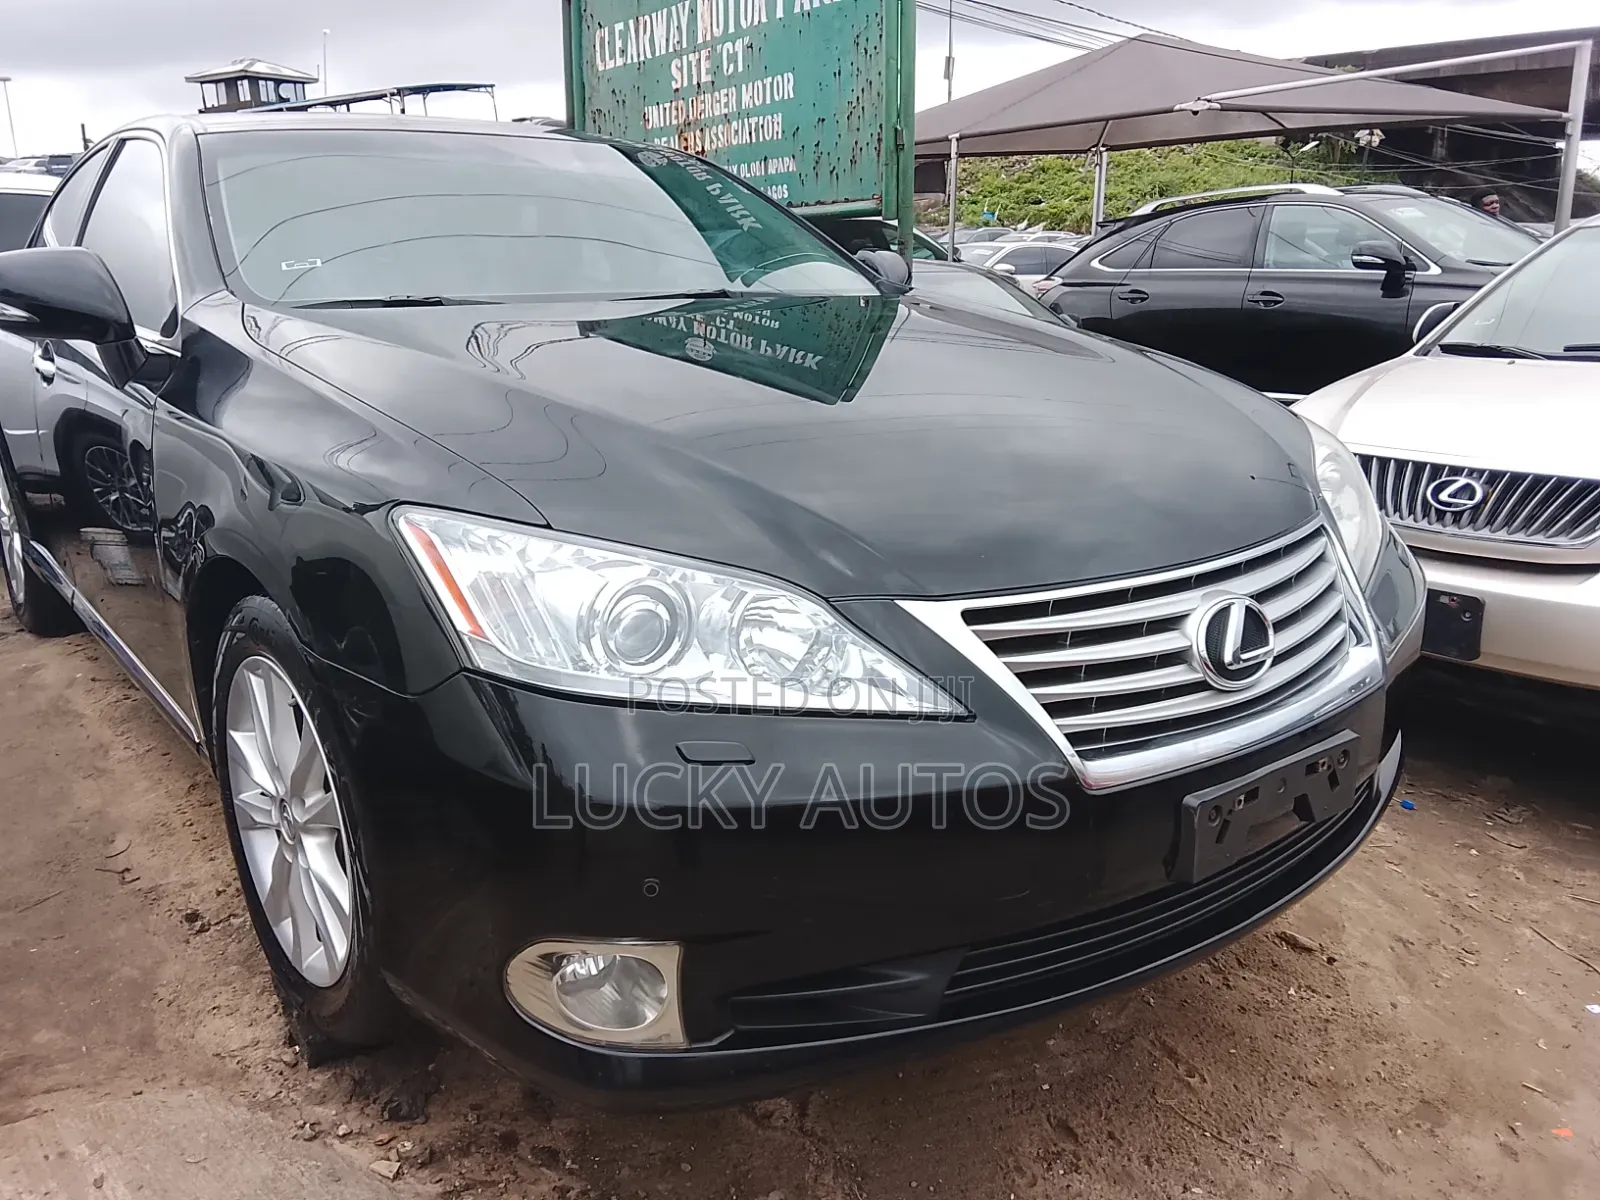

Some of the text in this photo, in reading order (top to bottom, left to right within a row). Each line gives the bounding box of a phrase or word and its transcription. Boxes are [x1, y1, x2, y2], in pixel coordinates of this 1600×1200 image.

[595, 0, 690, 71] CLEARWAY
[671, 48, 711, 89] SITE
[644, 99, 686, 130] UNITED
[741, 72, 795, 109] MOTOR
[703, 113, 782, 152] ASSOCIATION
